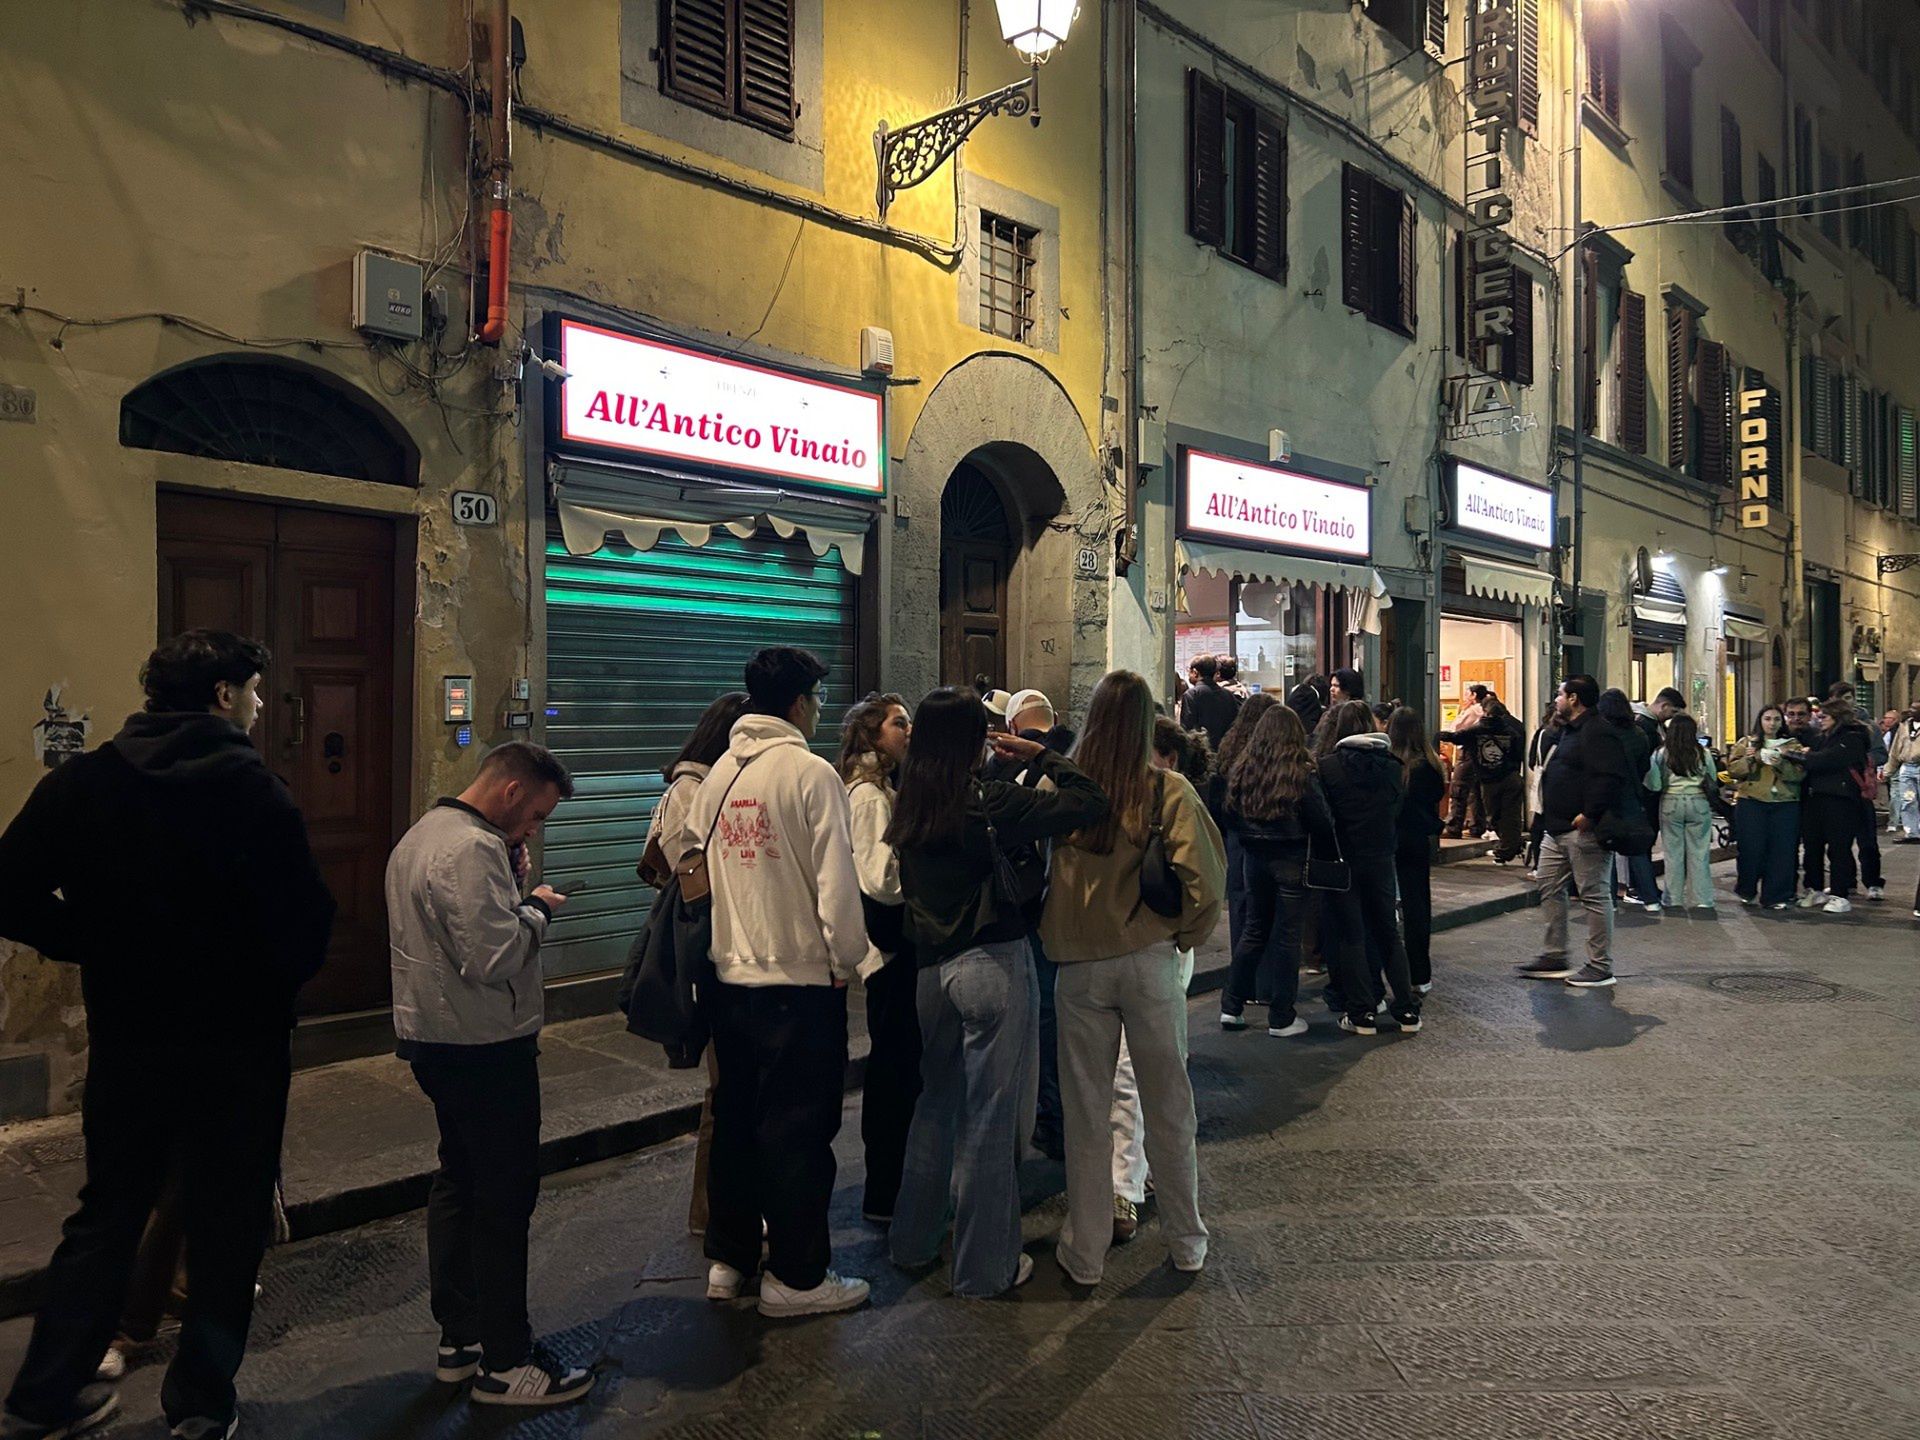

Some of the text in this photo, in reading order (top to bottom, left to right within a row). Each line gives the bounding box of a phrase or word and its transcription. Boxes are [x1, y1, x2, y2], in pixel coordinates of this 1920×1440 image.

[1473, 6, 1514, 411] ROSTICCERIA
[769, 425, 867, 469] Vinaio
[1740, 388, 1769, 529] FORNO
[460, 496, 489, 521] 30
[1517, 507, 1546, 532] Vinaio
[1302, 509, 1355, 539] Vinaio
[1082, 551, 1095, 569] 28
[1153, 591, 1164, 605] 76
